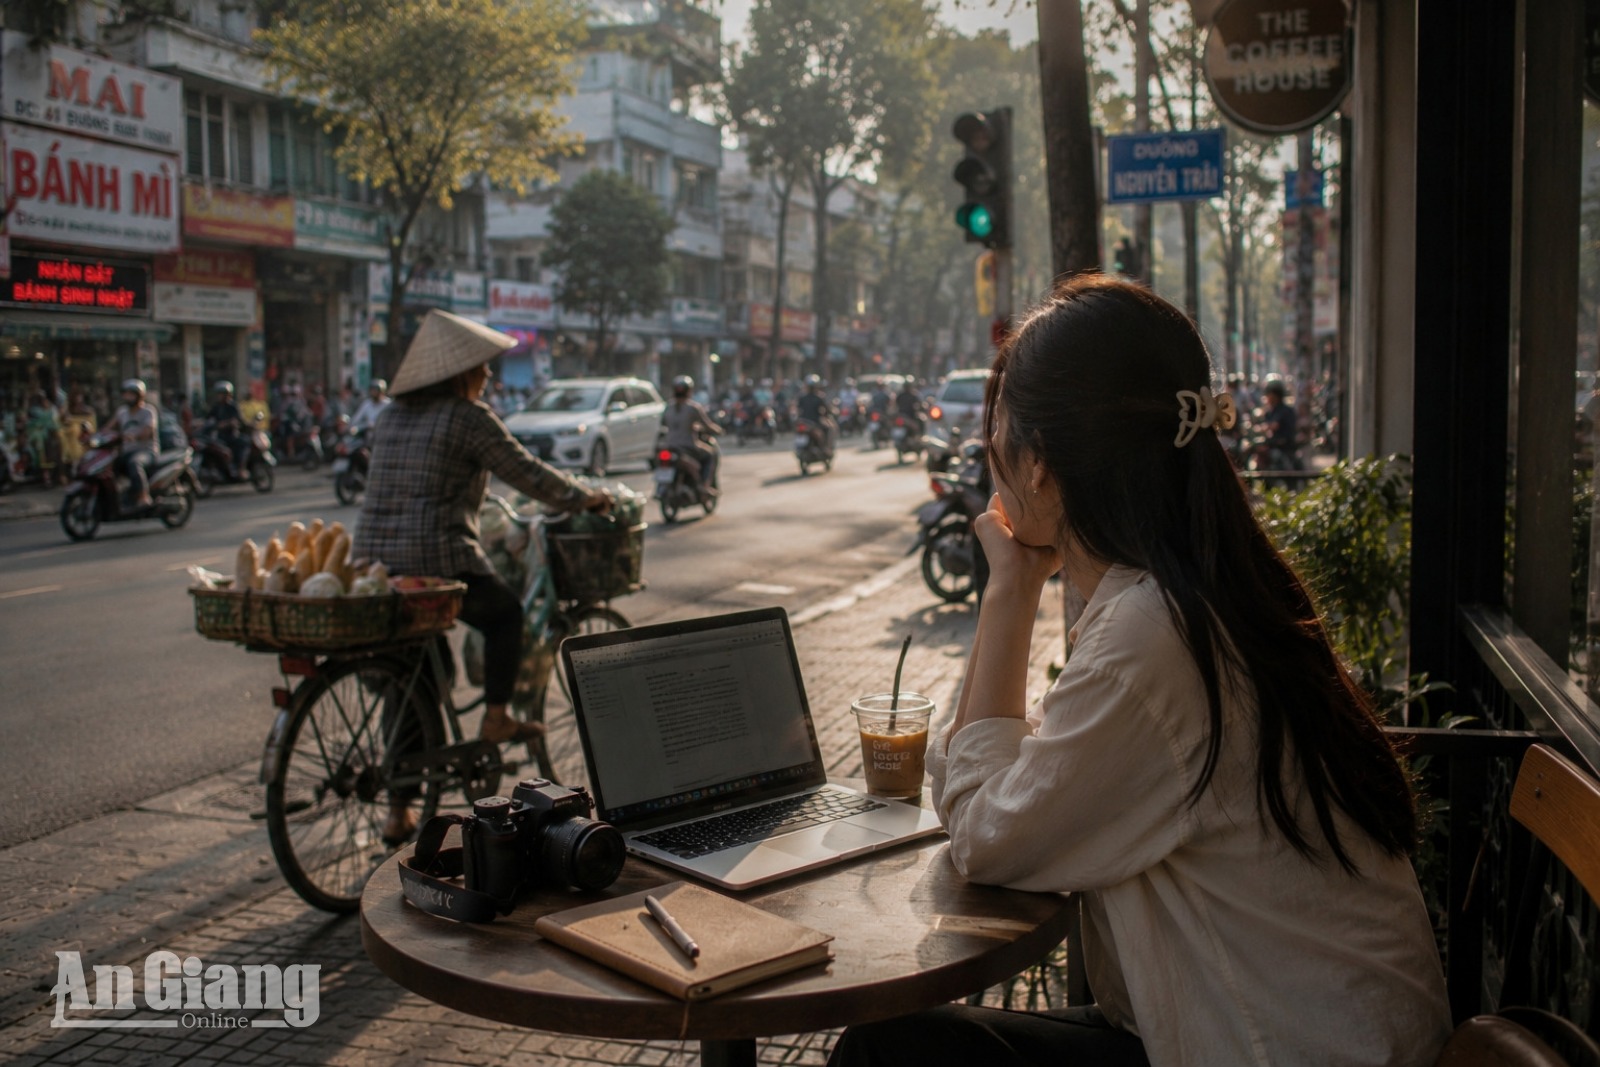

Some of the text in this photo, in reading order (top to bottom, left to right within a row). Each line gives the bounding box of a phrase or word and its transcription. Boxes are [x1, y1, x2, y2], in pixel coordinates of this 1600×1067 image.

[1259, 10, 1309, 35] THE
[1227, 36, 1342, 65] COFFEE
[1234, 66, 1330, 93] HOUSE
[12, 140, 173, 219] BÁNH MÌ
[60, 285, 95, 305] SINH
